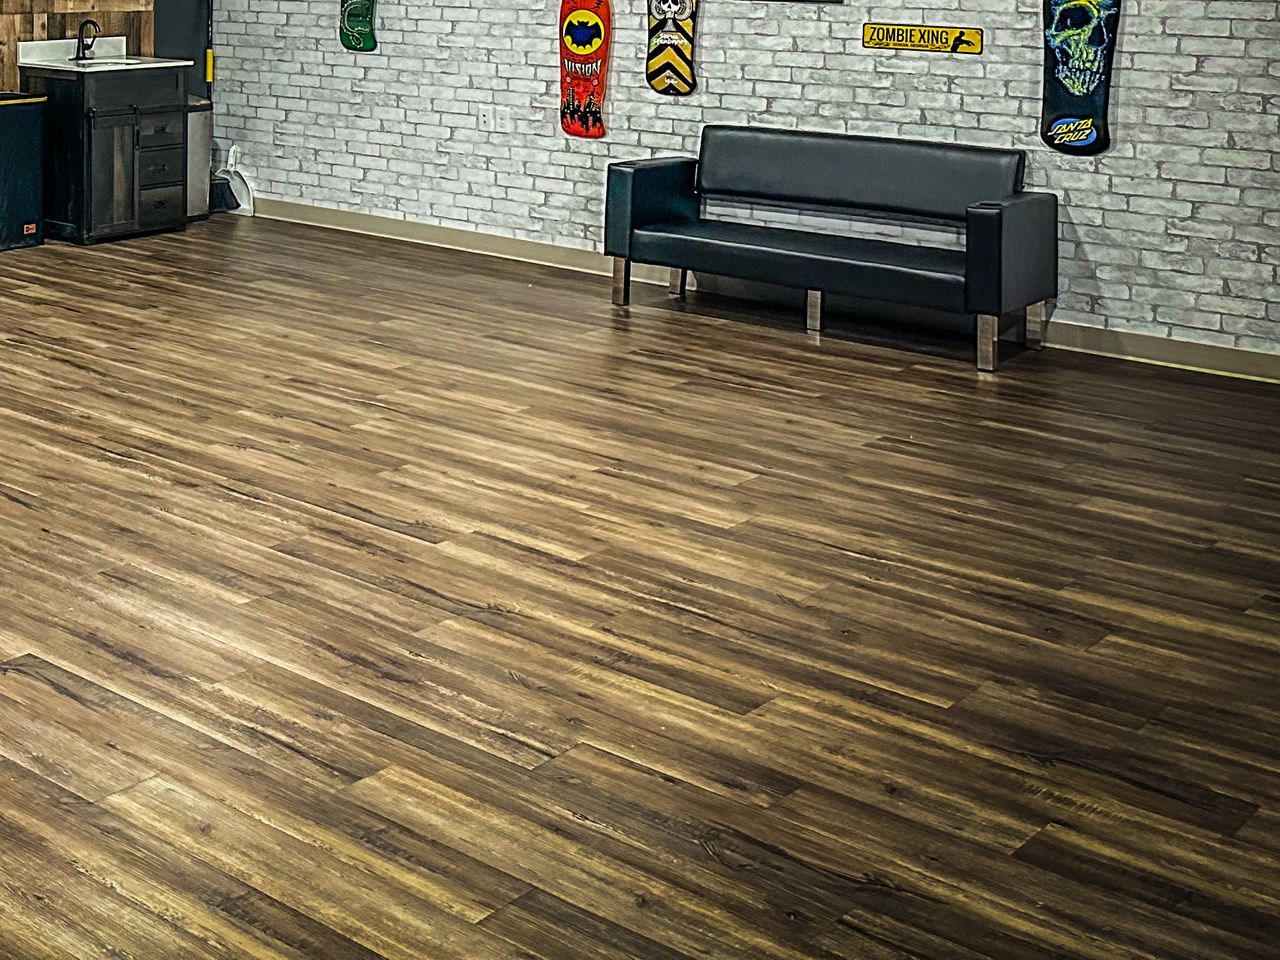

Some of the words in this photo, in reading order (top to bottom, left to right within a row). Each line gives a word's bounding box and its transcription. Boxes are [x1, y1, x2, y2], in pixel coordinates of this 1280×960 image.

[869, 26, 916, 43] ZOMBIE
[918, 29, 949, 45] XING
[564, 58, 602, 76] VISION
[1047, 118, 1093, 136] SANTA
[1054, 129, 1092, 144] CRUZ
